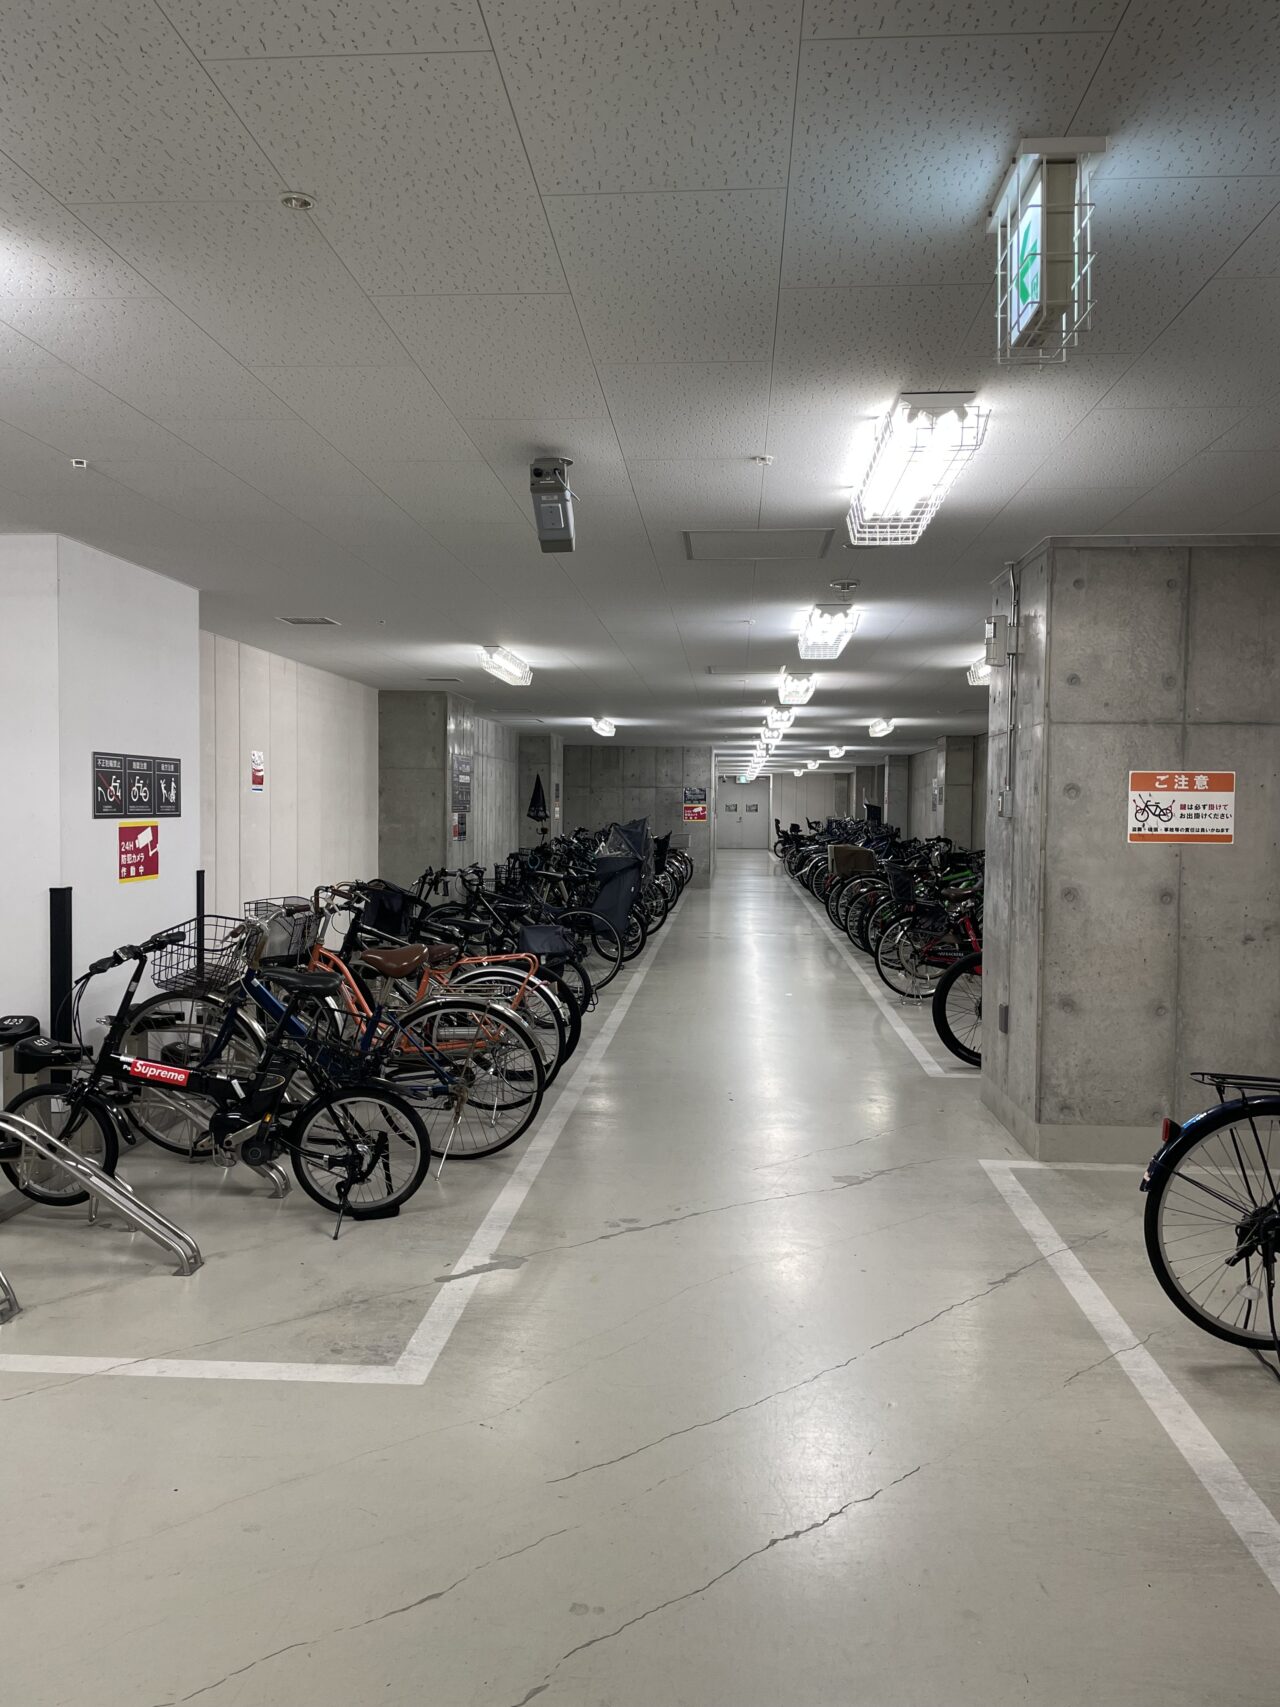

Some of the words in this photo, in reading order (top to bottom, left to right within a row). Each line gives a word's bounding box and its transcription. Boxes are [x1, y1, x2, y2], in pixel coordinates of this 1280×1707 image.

[1155, 774, 1209, 790] ご注意
[121, 841, 134, 852] 24H
[121, 852, 145, 865] 防犯カメラ
[121, 865, 145, 878] 作動中
[134, 1061, 185, 1081] Supreme
